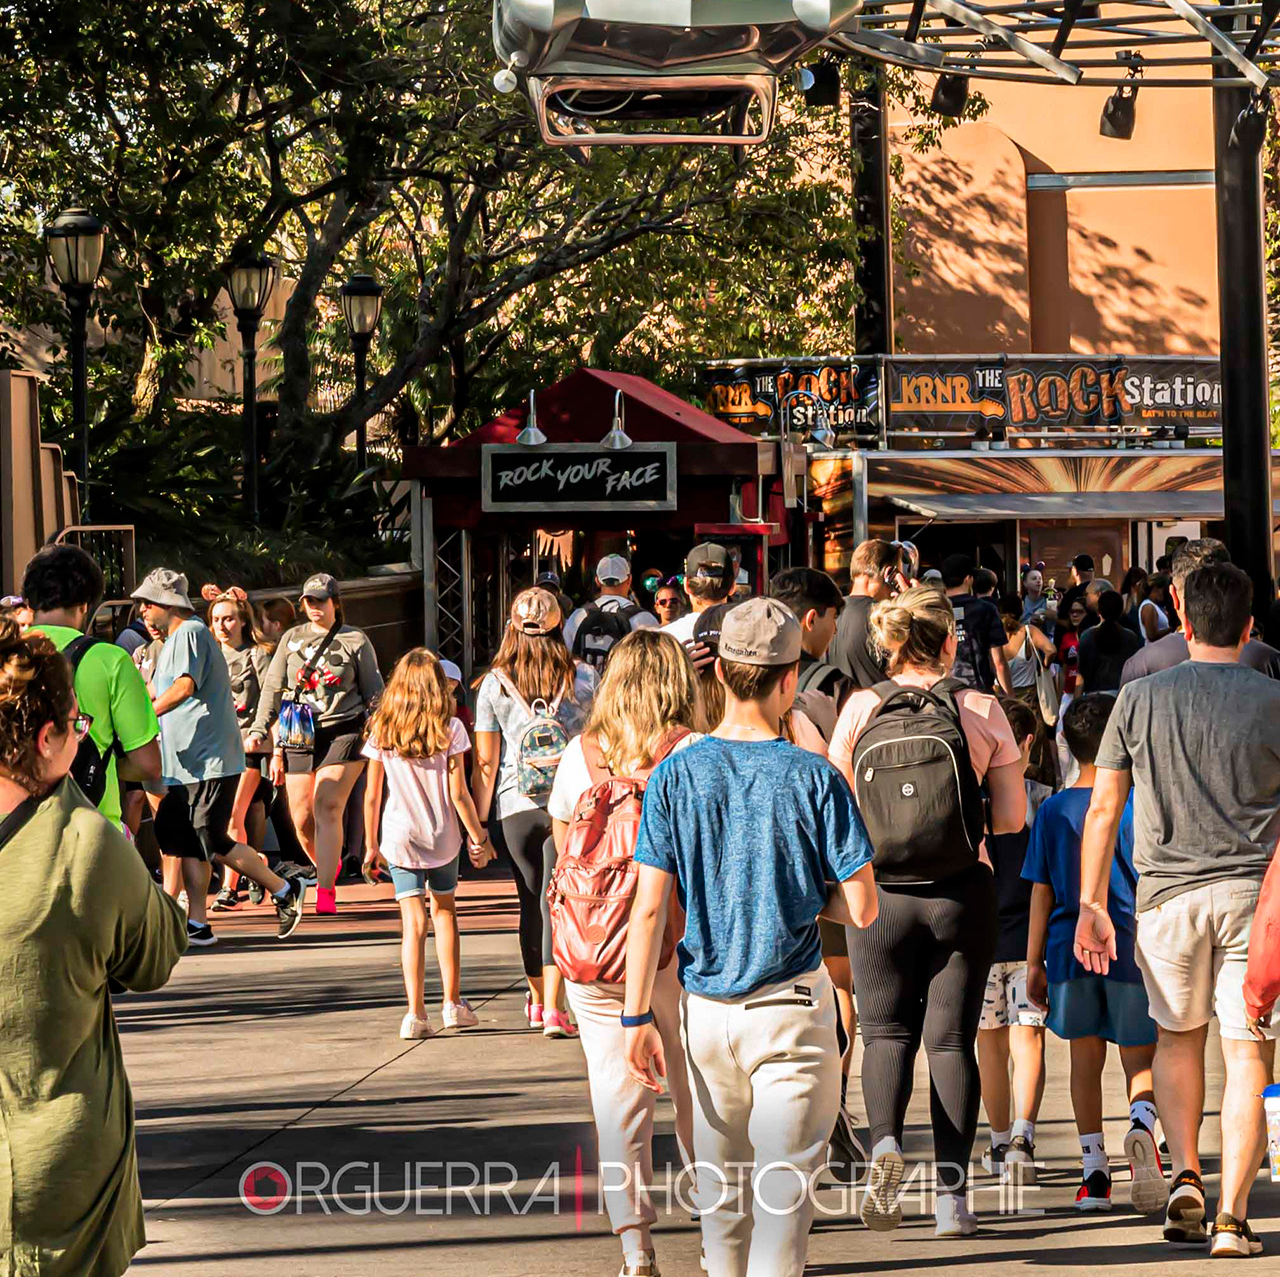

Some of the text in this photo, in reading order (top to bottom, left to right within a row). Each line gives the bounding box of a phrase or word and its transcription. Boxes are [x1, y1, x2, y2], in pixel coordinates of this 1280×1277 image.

[755, 375, 775, 393] THE
[777, 366, 860, 408] ROCK
[901, 366, 1222, 422] KRNR THE ROCK Station
[1166, 409, 1177, 419] TO
[1179, 409, 1194, 419] THE
[497, 458, 662, 496] ROCK YOUR FACE
